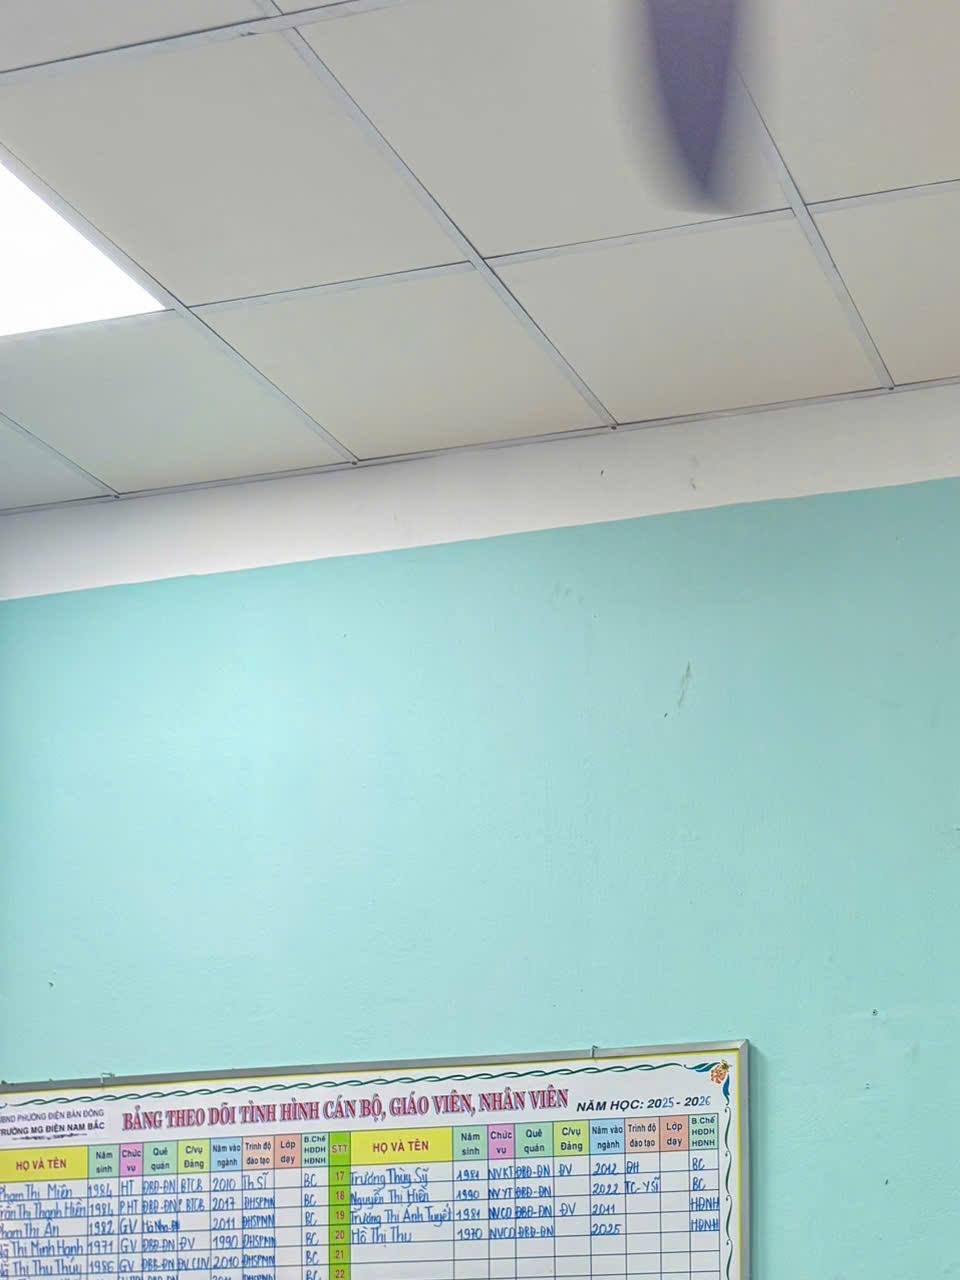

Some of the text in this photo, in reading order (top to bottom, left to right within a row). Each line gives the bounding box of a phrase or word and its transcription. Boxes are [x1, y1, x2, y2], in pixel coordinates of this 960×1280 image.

[122, 1105, 163, 1131] BẢNG
[166, 1109, 205, 1127] THEO
[208, 1102, 236, 1125] DÕI
[239, 1099, 276, 1123] TÌNH
[280, 1097, 320, 1121] HÌNH
[323, 1094, 356, 1119] CÁN
[389, 1091, 430, 1117] GIÁO
[432, 1090, 476, 1117] VIÊN,
[479, 1087, 525, 1112] NHÂN
[529, 1084, 569, 1109] VIÊN
[576, 1100, 606, 1112] NĂM
[610, 1099, 644, 1112] HỌC:
[647, 1097, 674, 1109] 2025
